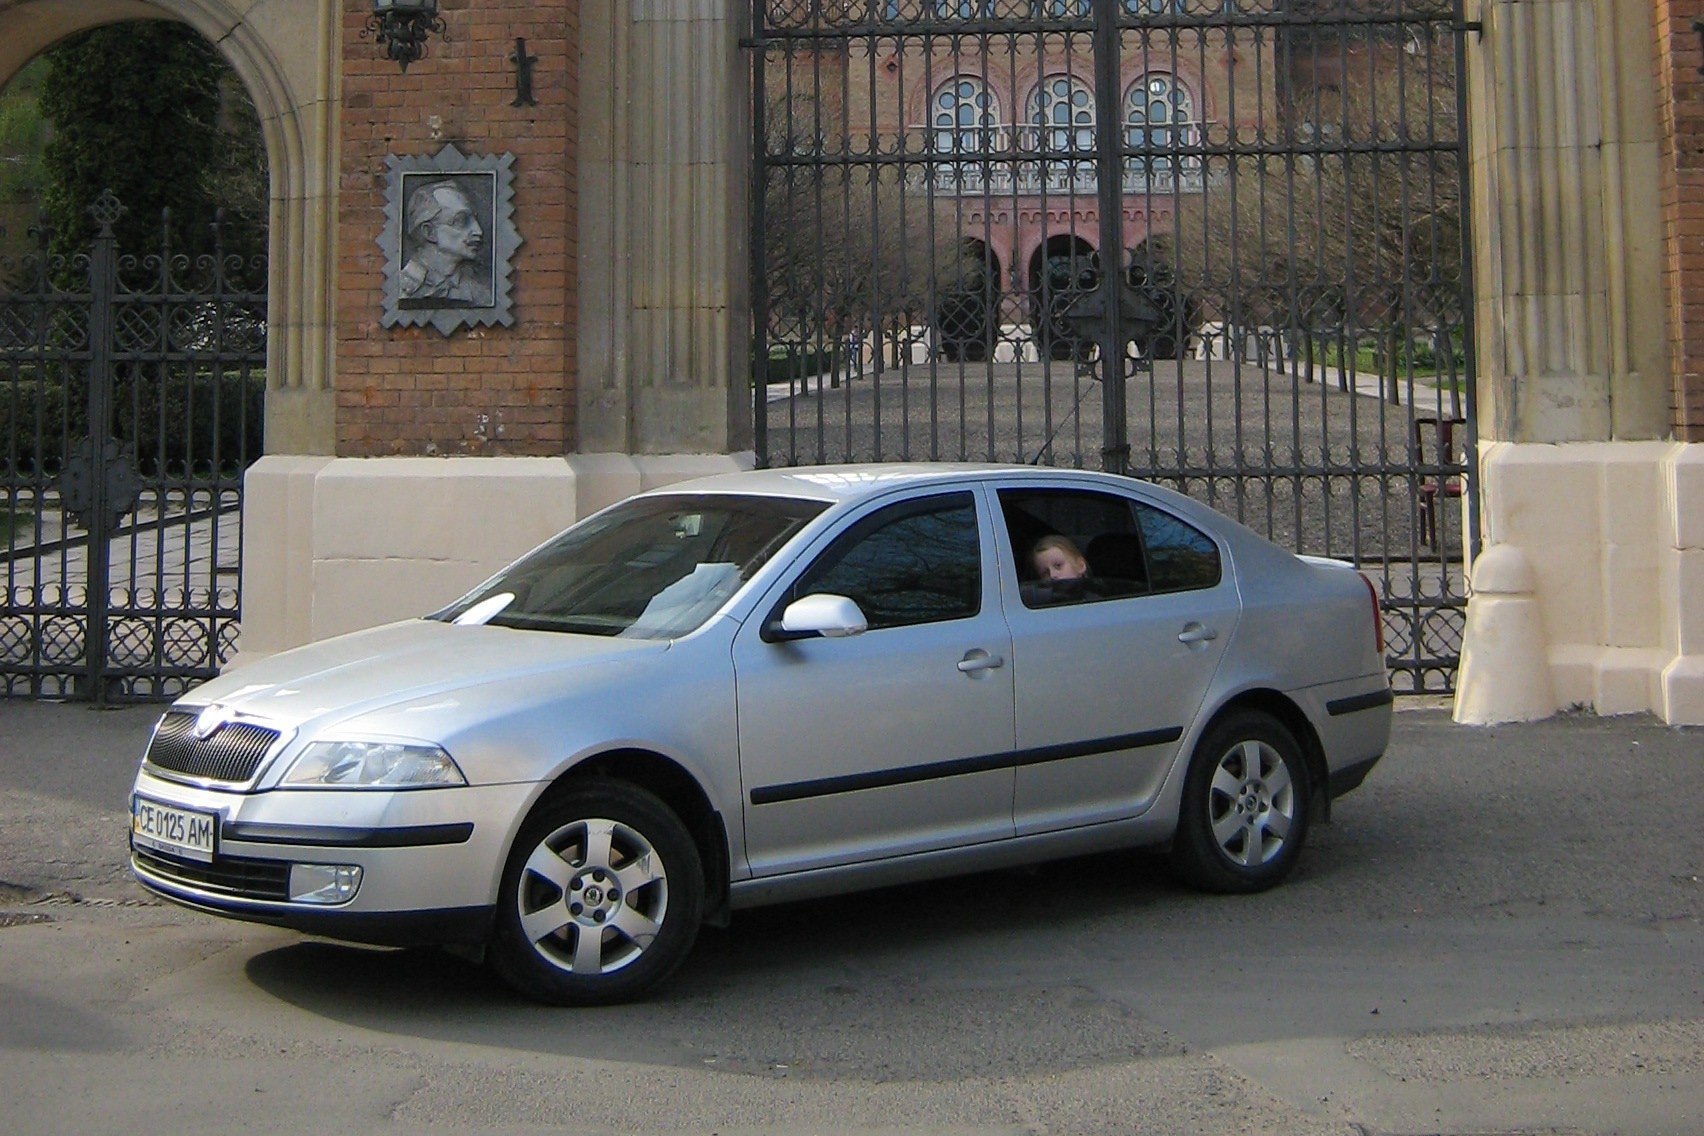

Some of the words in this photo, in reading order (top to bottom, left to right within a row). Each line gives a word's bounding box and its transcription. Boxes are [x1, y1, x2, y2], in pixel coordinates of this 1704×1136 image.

[140, 805, 154, 833] CE
[156, 809, 185, 841] 0125
[188, 817, 210, 847] AM
